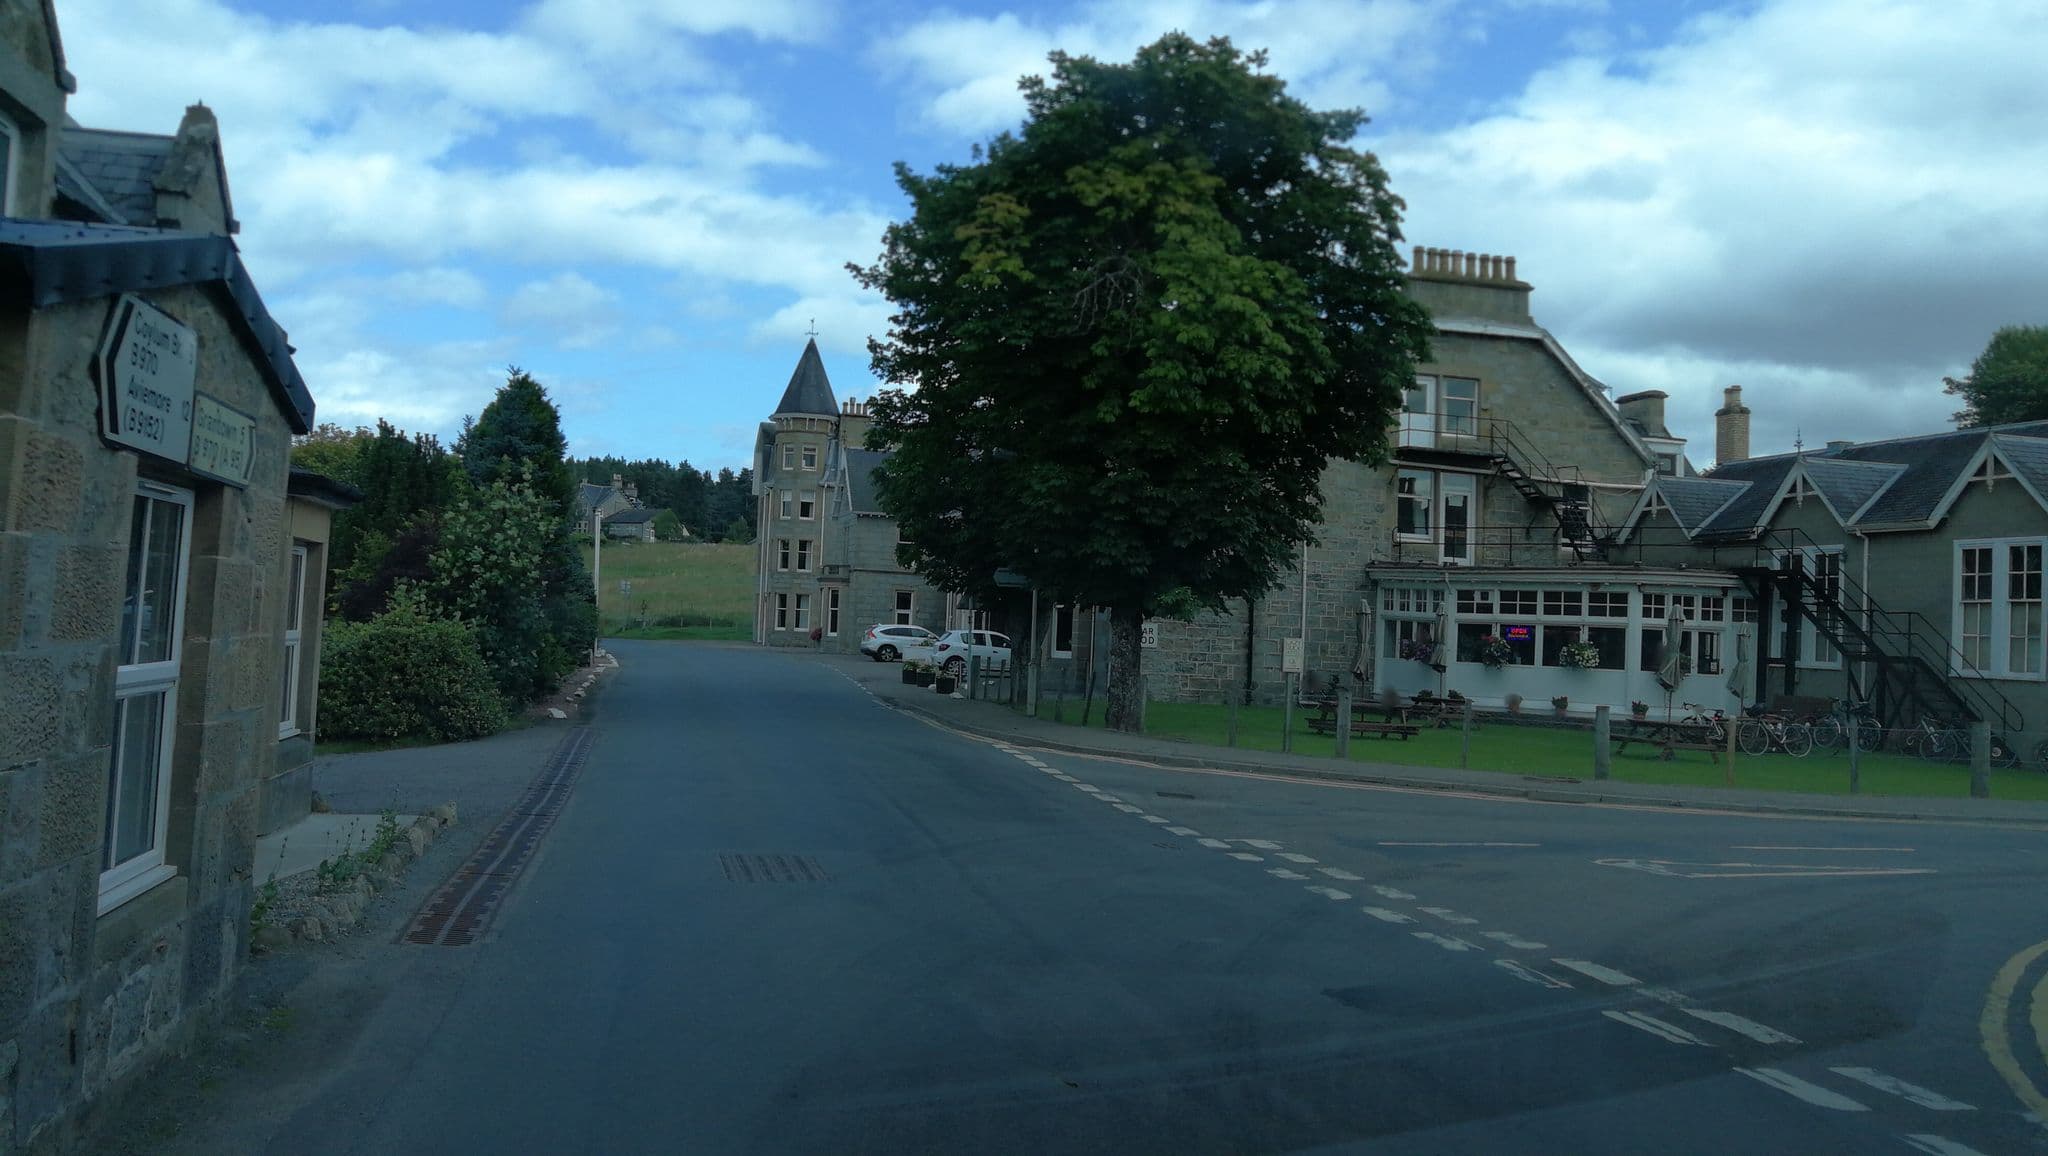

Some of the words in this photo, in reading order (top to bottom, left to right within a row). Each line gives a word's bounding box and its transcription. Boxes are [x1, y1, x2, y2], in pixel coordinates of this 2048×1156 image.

[128, 374, 172, 414] Aviemore
[1140, 627, 1154, 635] AR
[1140, 636, 1155, 644] OD
